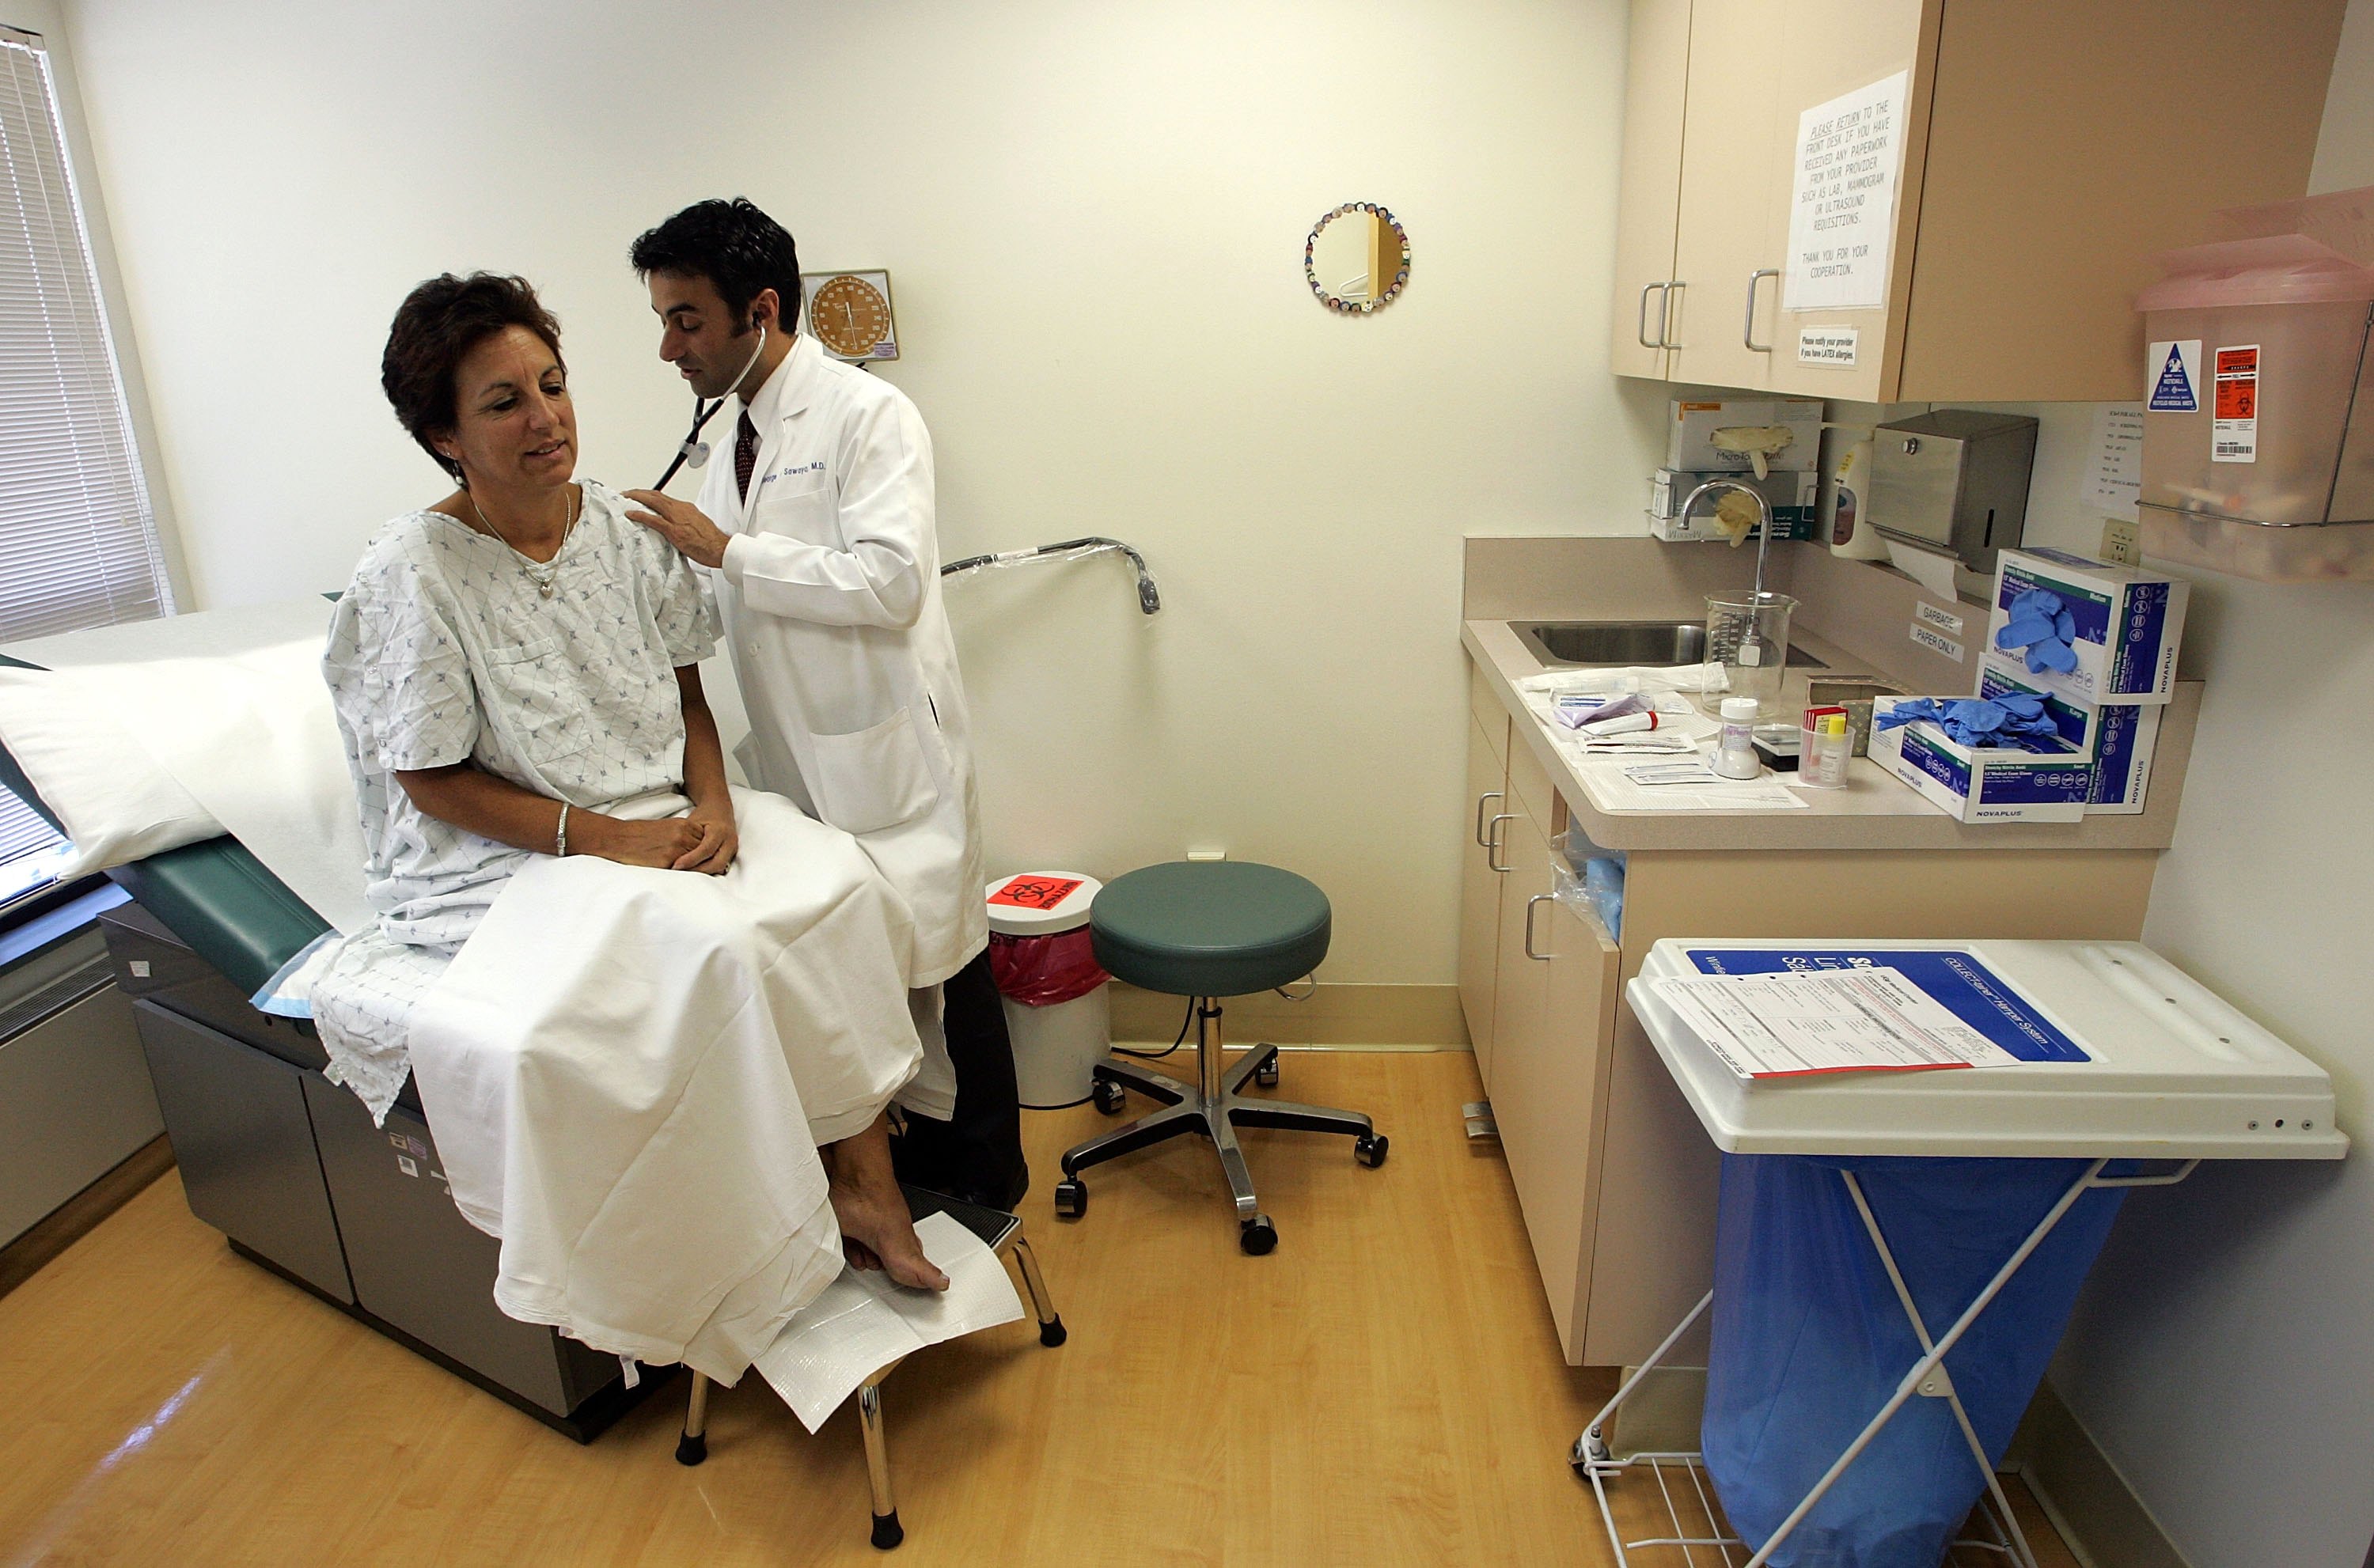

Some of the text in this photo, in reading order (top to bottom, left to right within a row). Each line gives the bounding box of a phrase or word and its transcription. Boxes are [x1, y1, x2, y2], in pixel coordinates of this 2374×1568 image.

[1811, 100, 1888, 138] PLEASE RETURN TO THE
[1806, 117, 1890, 155] FRONT DESK IF YOU HAVE
[1804, 135, 1888, 171] RECEIVED ANY PAPERWORK
[1811, 156, 1878, 185] FROM YOUR PROVIDER
[1802, 172, 1884, 203] SUCH AS LAB, MAMMOGRAM
[1815, 195, 1864, 215] OR ULTRASOUND
[1814, 212, 1861, 231] REQUISITIONS.
[1803, 244, 1868, 264] THANK YOU FOR YOUR
[1811, 263, 1853, 278] COOPERATION.
[1802, 336, 1814, 345] Please
[1815, 337, 1825, 347] notify
[1836, 338, 1853, 347] provider
[1924, 608, 1955, 629] GARBAGE
[1917, 629, 1956, 655] PAPER ONLY
[1994, 646, 2024, 664] NOVAPLUS
[2160, 646, 2173, 693] NOVAPLUS
[1898, 767, 1923, 788] NOVAPLUS
[2132, 759, 2145, 804] NOVAPLUS
[1705, 956, 1727, 975] Winfie
[1994, 998, 2023, 1022] Hamper
[2019, 1022, 2048, 1044] System
